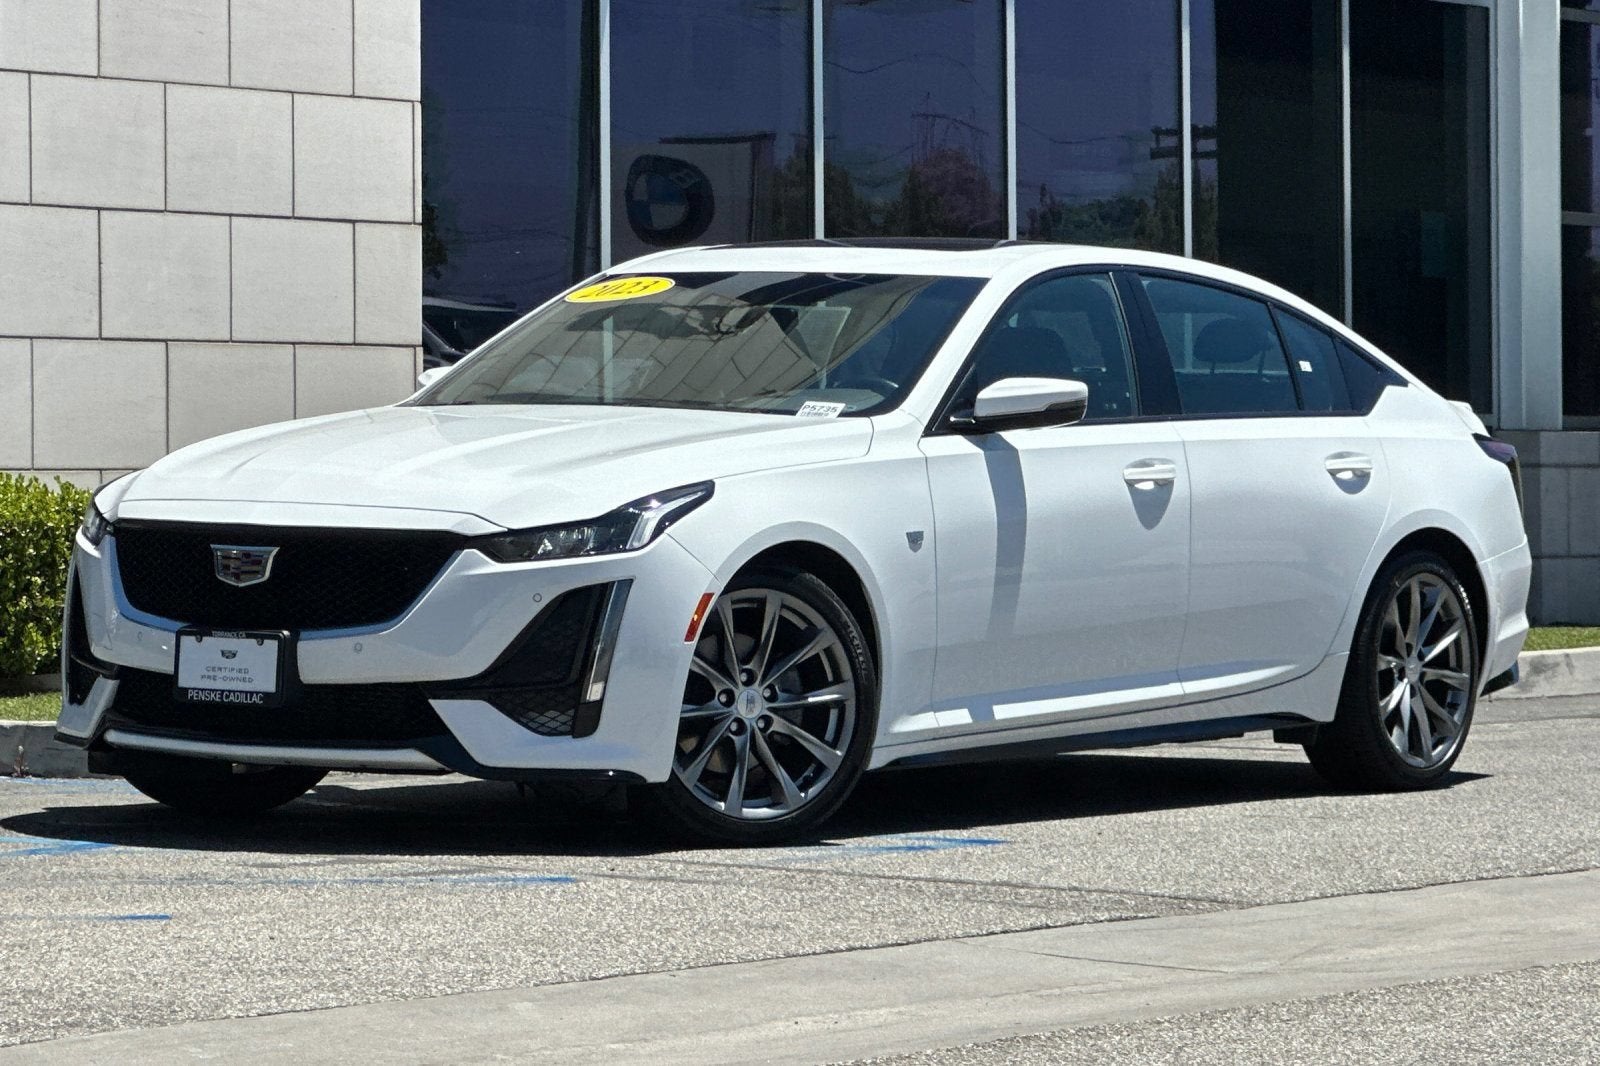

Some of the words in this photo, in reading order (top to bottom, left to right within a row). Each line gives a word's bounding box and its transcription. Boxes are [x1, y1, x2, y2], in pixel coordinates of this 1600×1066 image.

[577, 280, 661, 299] 2023
[802, 404, 839, 413] P5735
[205, 666, 250, 675] CERTIFIED
[201, 675, 254, 684] PRE-OWNED
[188, 689, 221, 702] PENSKE
[223, 692, 264, 704] CADILLAC
